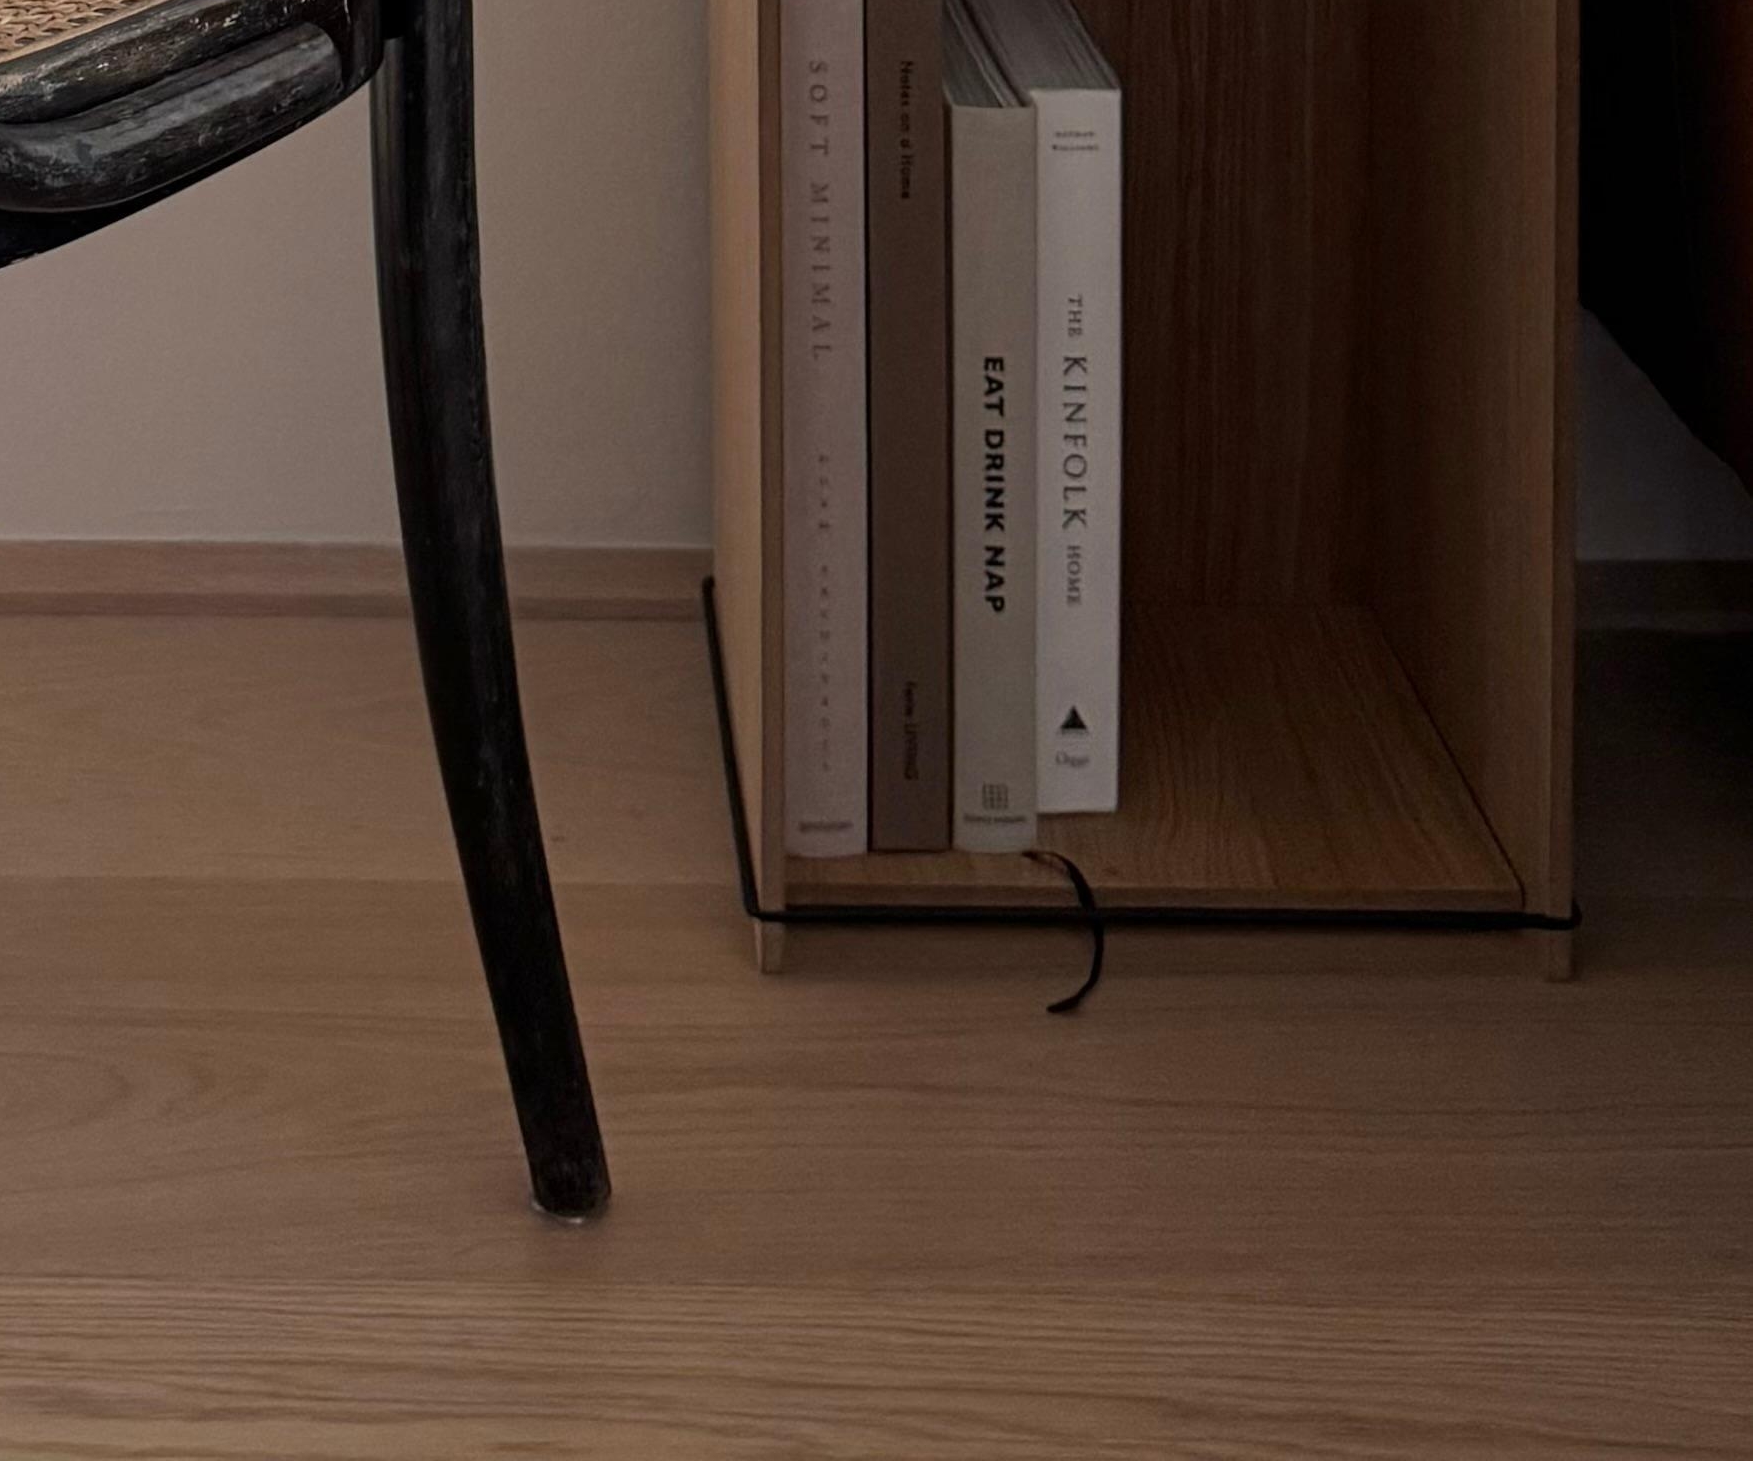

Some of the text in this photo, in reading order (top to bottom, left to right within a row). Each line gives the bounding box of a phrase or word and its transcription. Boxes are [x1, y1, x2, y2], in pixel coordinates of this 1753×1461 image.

[808, 60, 833, 361] SOFT MINIMAL
[899, 60, 914, 107] Notes
[983, 356, 1006, 614] EAT DRINK NAP
[1062, 294, 1087, 607] THE KINFOLK HOME
